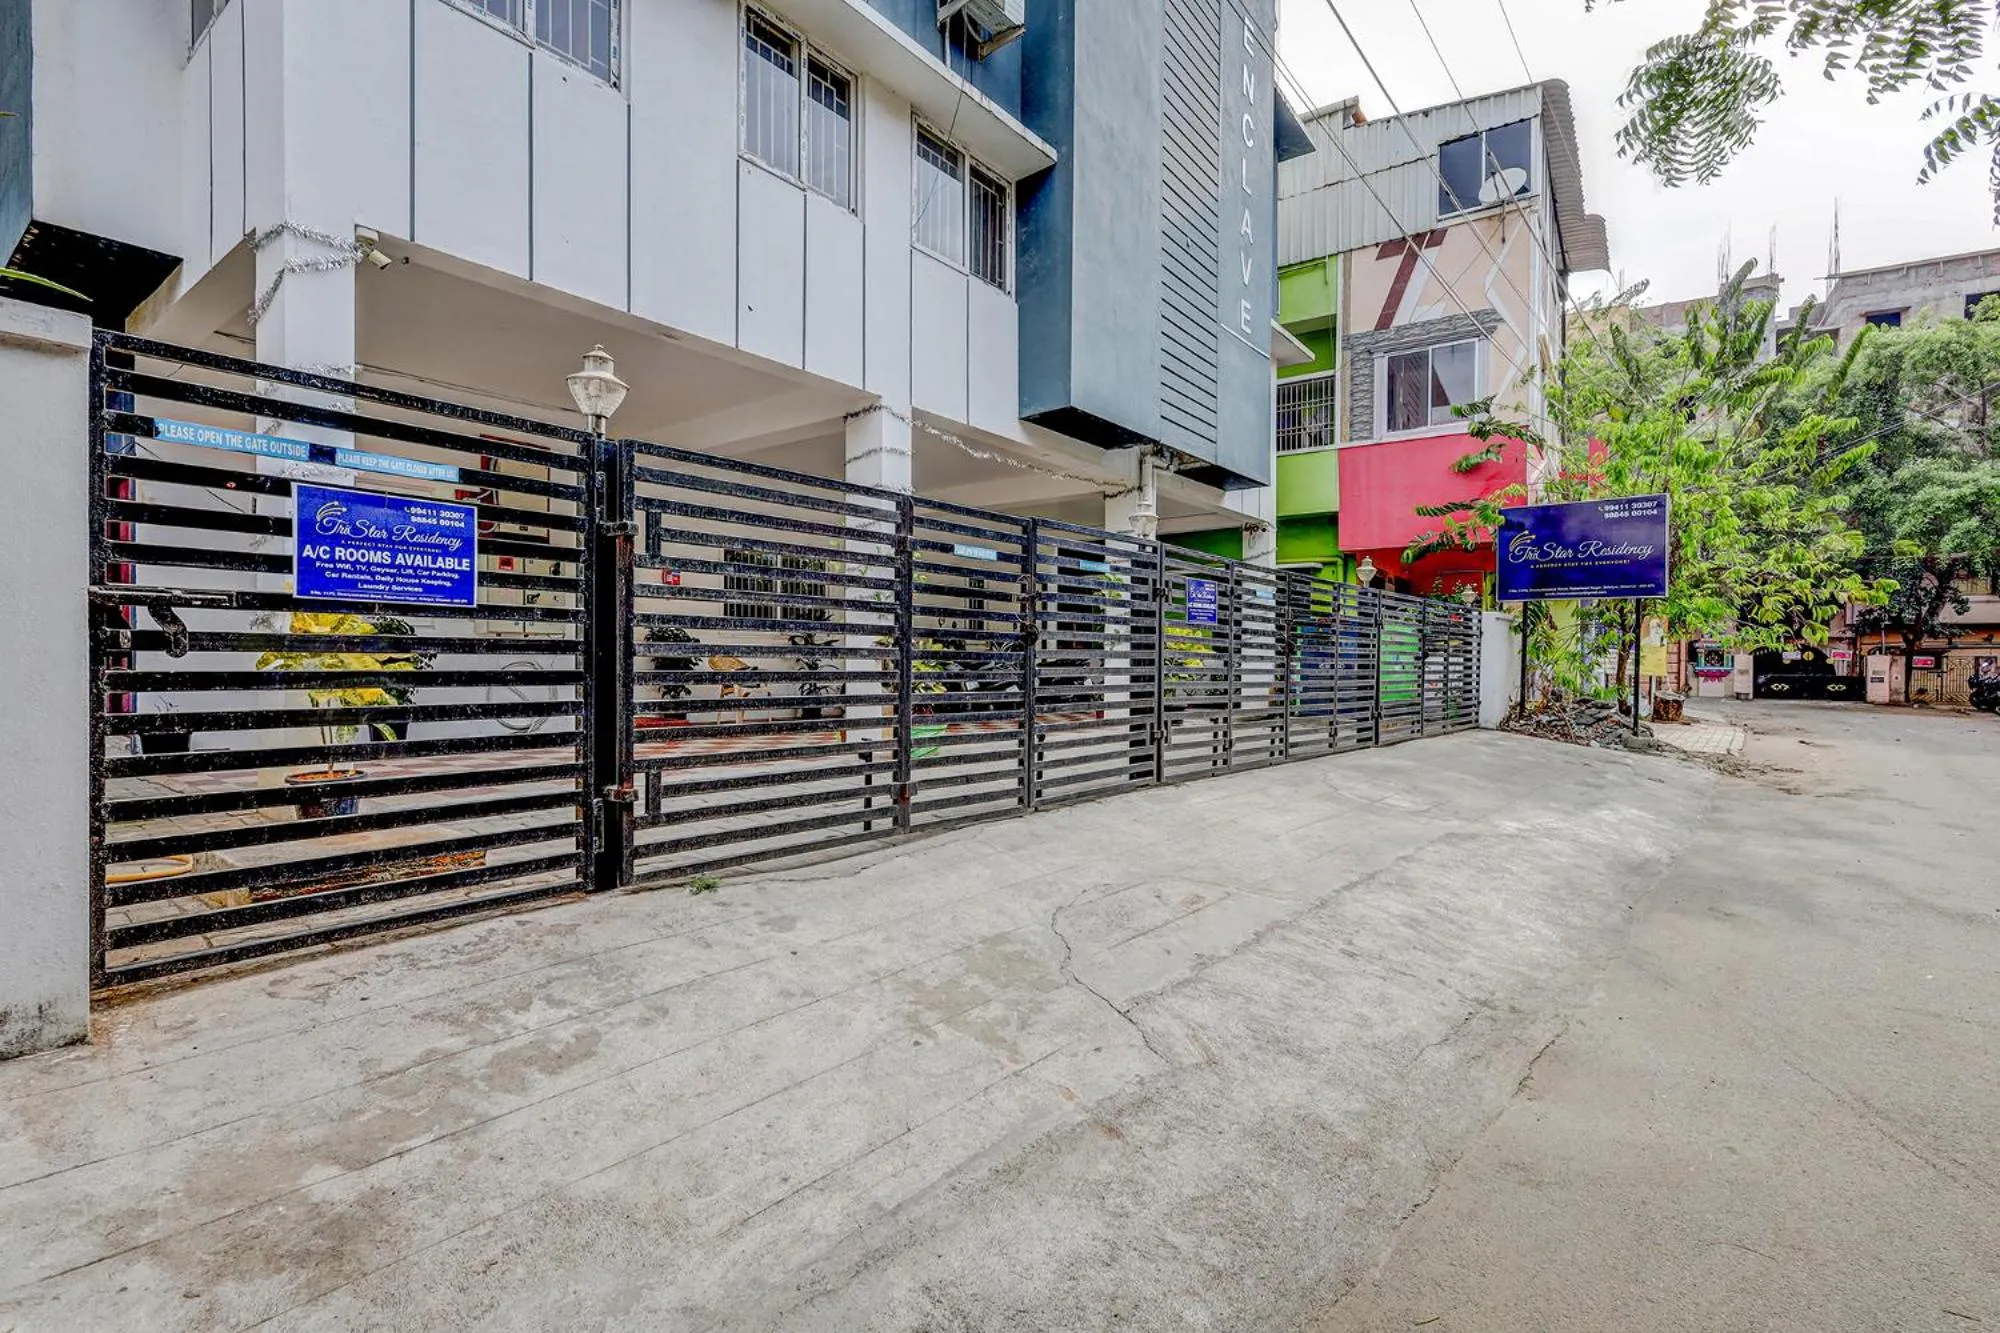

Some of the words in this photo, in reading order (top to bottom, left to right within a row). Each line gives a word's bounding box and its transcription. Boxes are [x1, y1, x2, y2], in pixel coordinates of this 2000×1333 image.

[1240, 16, 1256, 334] ENCLAVE
[159, 423, 194, 440] PLEASE
[197, 430, 222, 445] OPEN
[225, 434, 243, 449] THE
[245, 437, 268, 452] GATE
[392, 525, 463, 551] Residency
[302, 544, 330, 559] A/C
[335, 547, 391, 565] ROOMS
[395, 552, 471, 571] AVAILABLE
[1578, 540, 1655, 560] Residency
[315, 561, 335, 569] Free
[356, 565, 369, 573] TV,
[370, 566, 399, 575] Geyser,
[417, 569, 430, 578] Car
[325, 571, 339, 579] Car
[341, 572, 374, 581] Rentals,
[375, 574, 394, 583] Daily
[395, 576, 419, 584] House
[358, 582, 390, 592] Laundry
[391, 585, 423, 593] Services
